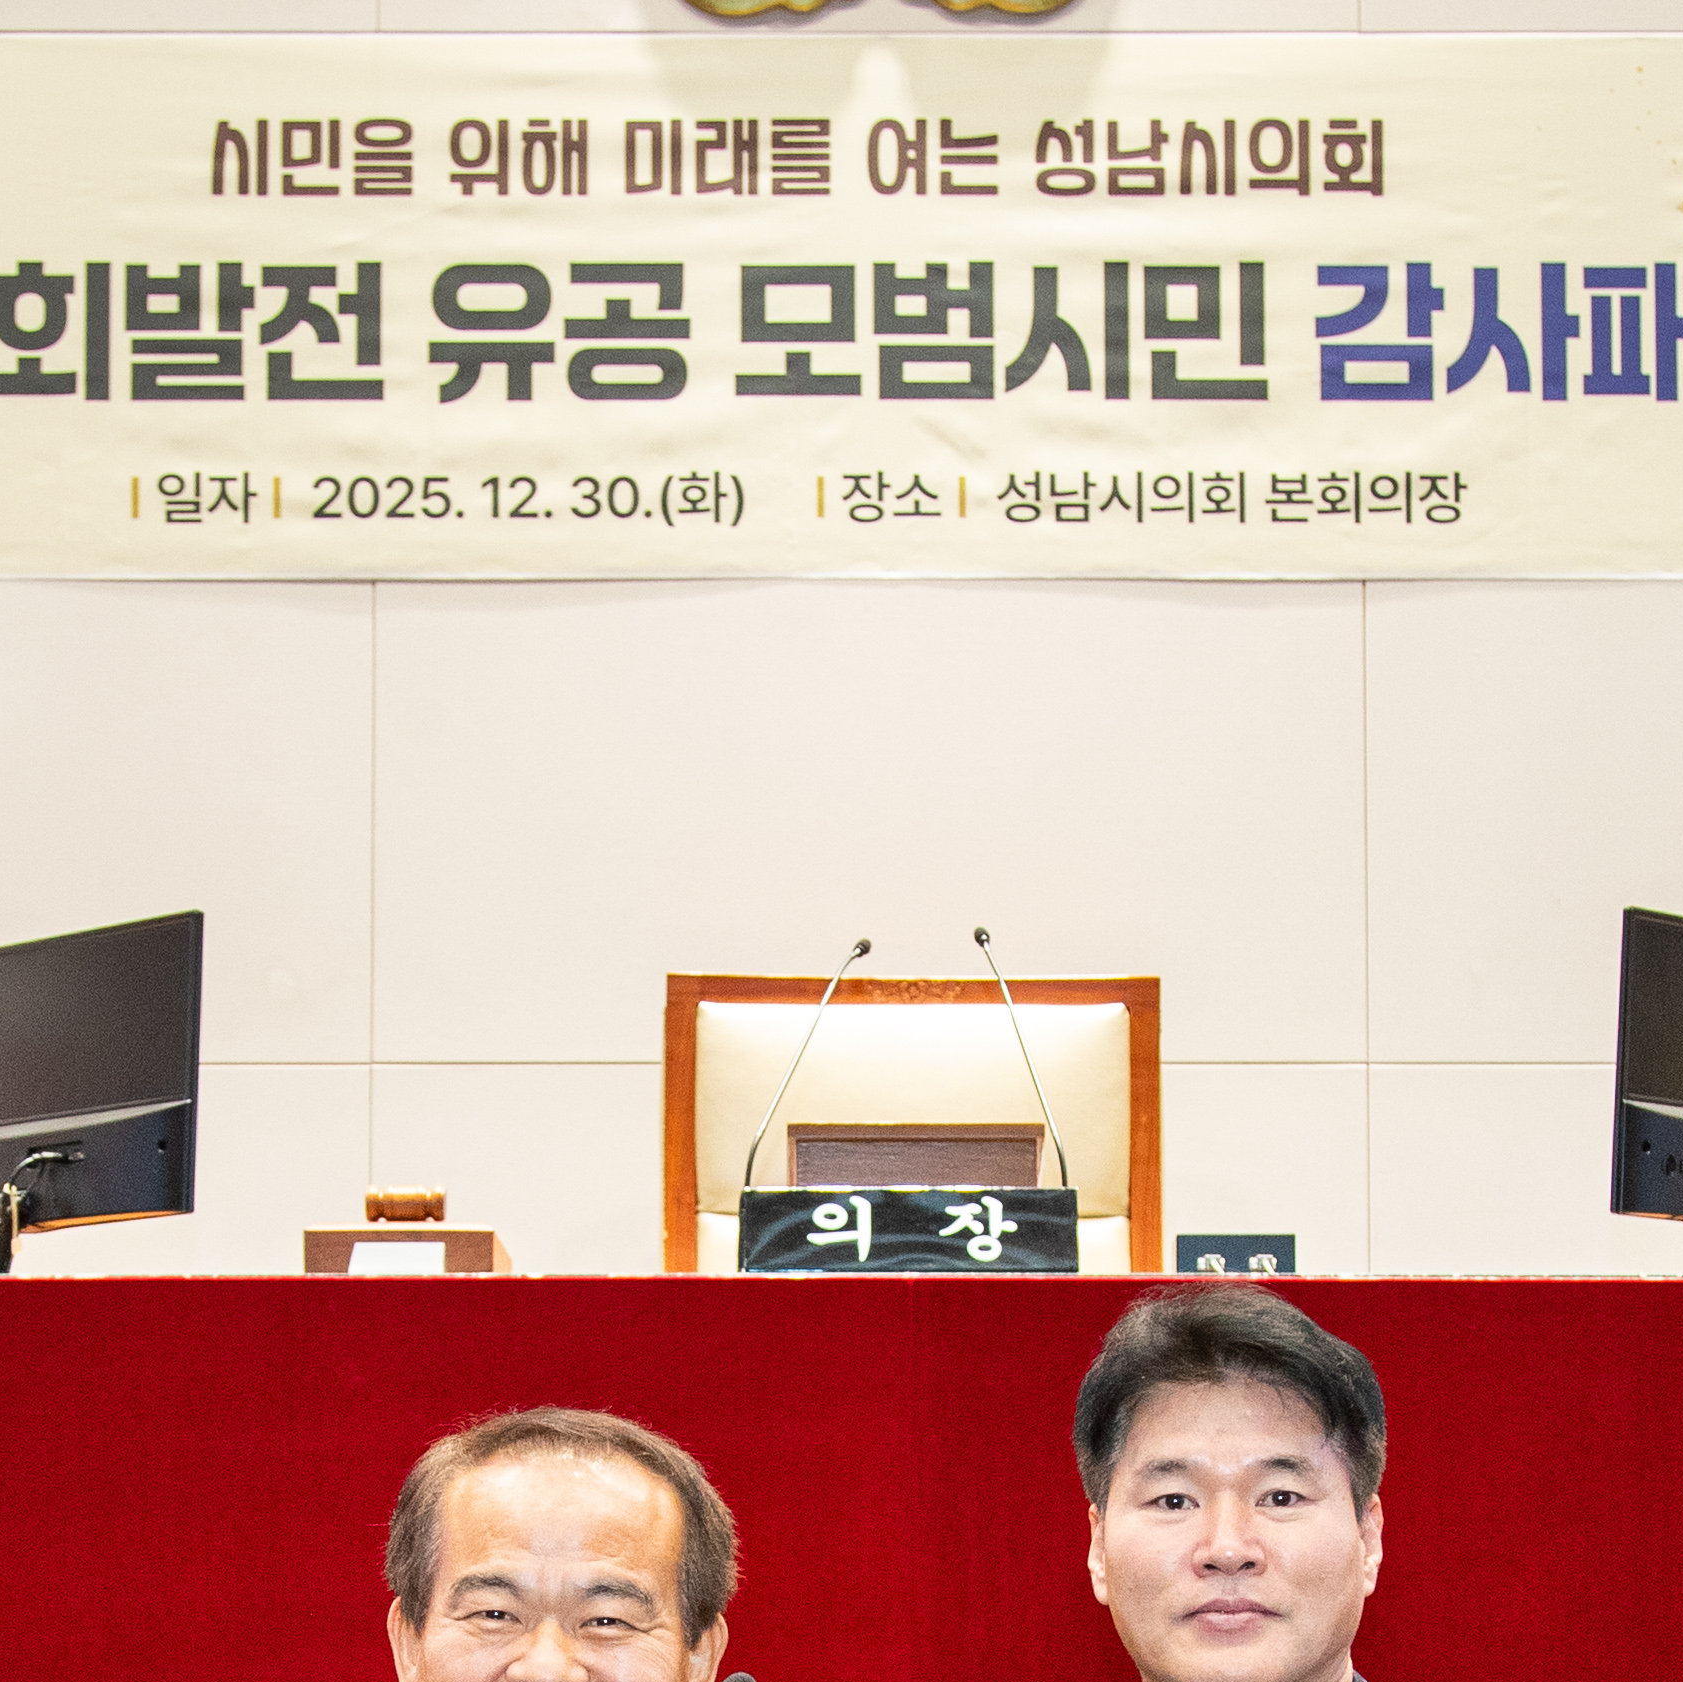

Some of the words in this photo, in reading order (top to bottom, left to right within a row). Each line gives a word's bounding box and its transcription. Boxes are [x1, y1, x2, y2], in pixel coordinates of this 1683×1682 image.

[210, 117, 414, 196] 시민을
[449, 117, 589, 196] 위해
[624, 117, 831, 196] 미래를
[867, 116, 1000, 196] 여는
[1035, 117, 1385, 197] 성남시의회
[428, 261, 692, 404] 유공
[735, 260, 1269, 402] 모범시민
[157, 471, 258, 525] 일자
[311, 474, 465, 520] 2025.
[481, 474, 554, 520] 12.
[571, 471, 746, 527] 30.(화)
[843, 470, 942, 524] 장소
[997, 470, 1247, 525] 성남시의회
[1265, 470, 1469, 525] 본회의장
